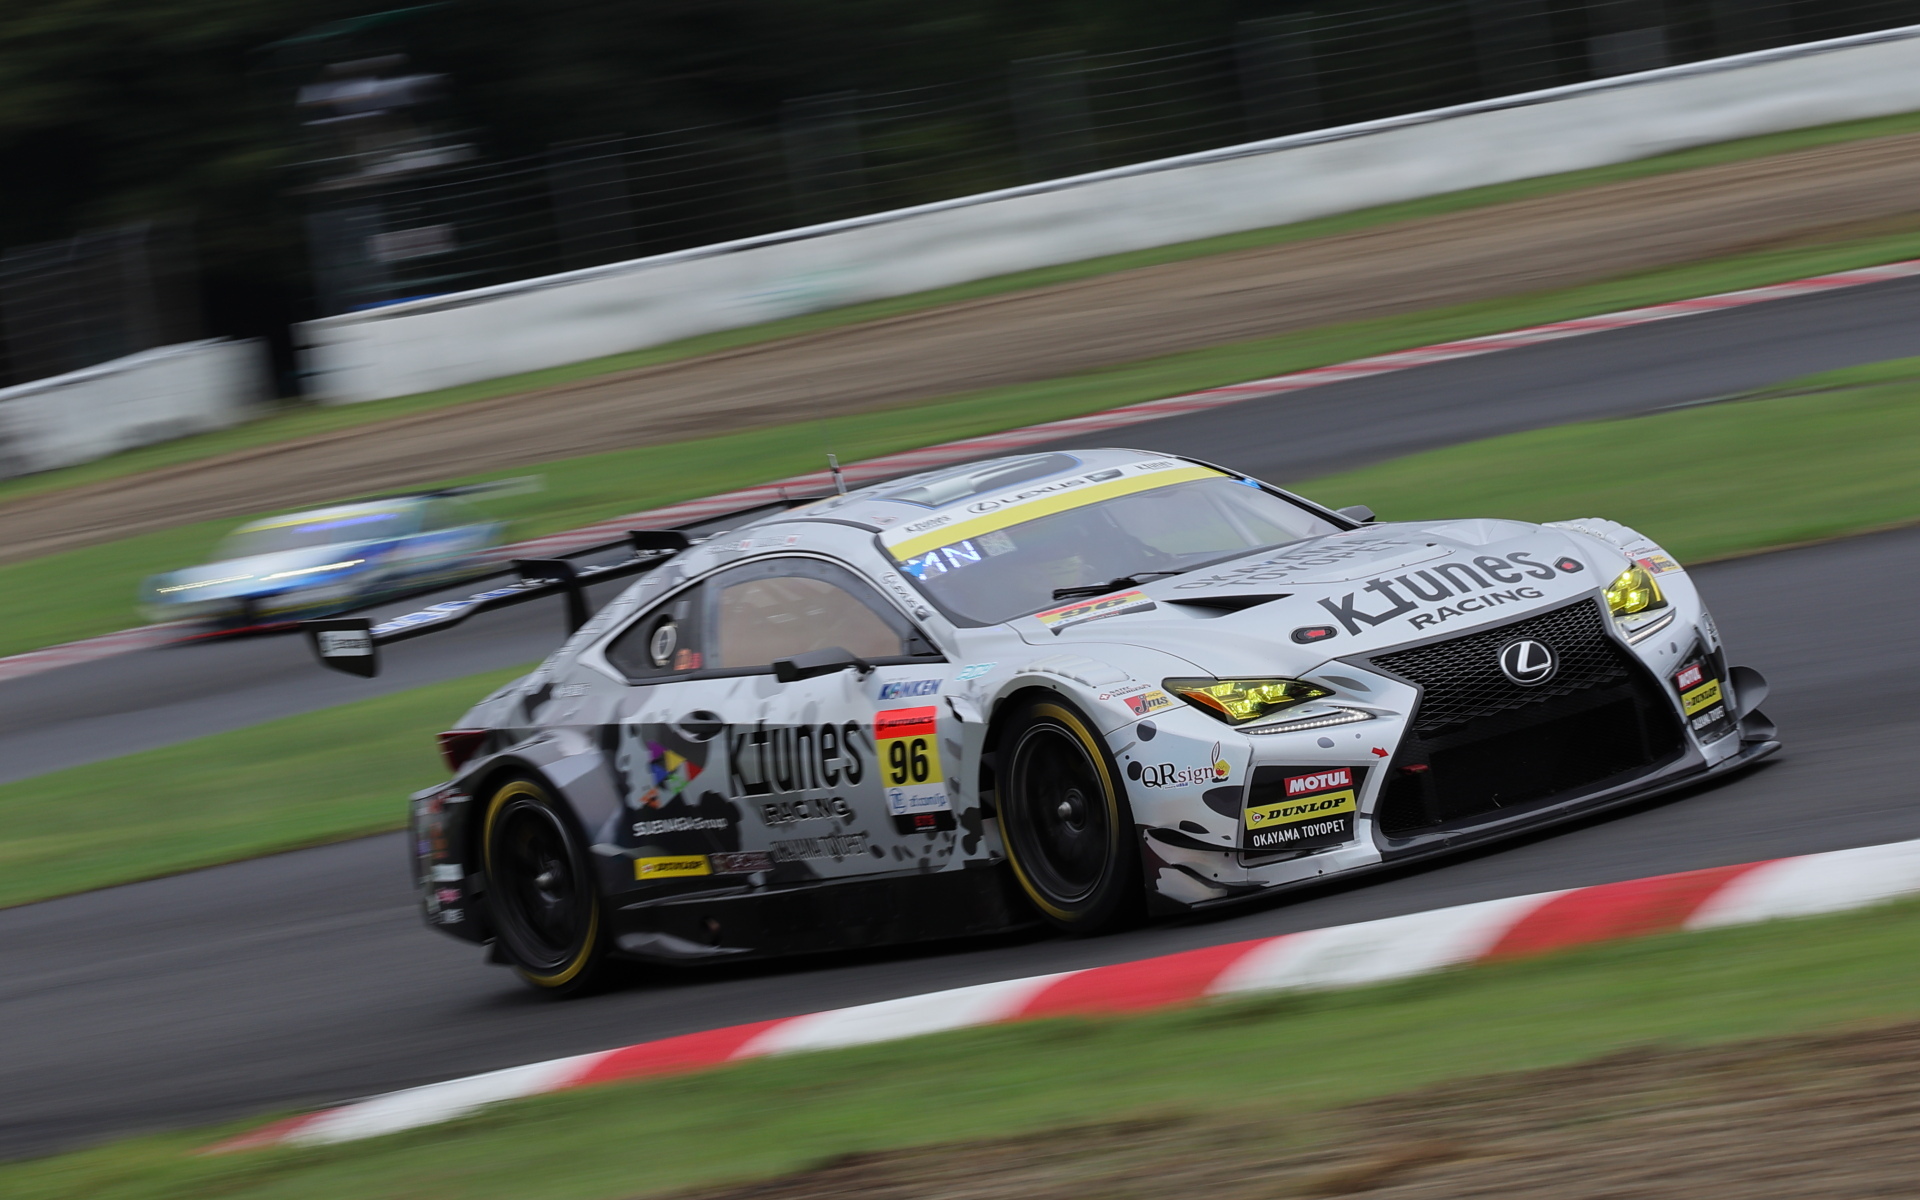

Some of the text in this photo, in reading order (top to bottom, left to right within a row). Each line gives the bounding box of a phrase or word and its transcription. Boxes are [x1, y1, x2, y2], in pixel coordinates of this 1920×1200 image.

[1001, 480, 1085, 504] LEXUS
[1218, 540, 1410, 587] TOYOPET
[1060, 597, 1128, 619] 96
[1408, 587, 1544, 631] RACING
[888, 737, 930, 784] 96
[1141, 763, 1215, 789] QRsign
[1289, 769, 1349, 793] MOTUL
[761, 797, 850, 825] RACING
[1267, 796, 1347, 820] DUNLOP
[1252, 819, 1346, 848] OKAYAMA TOYOPET
